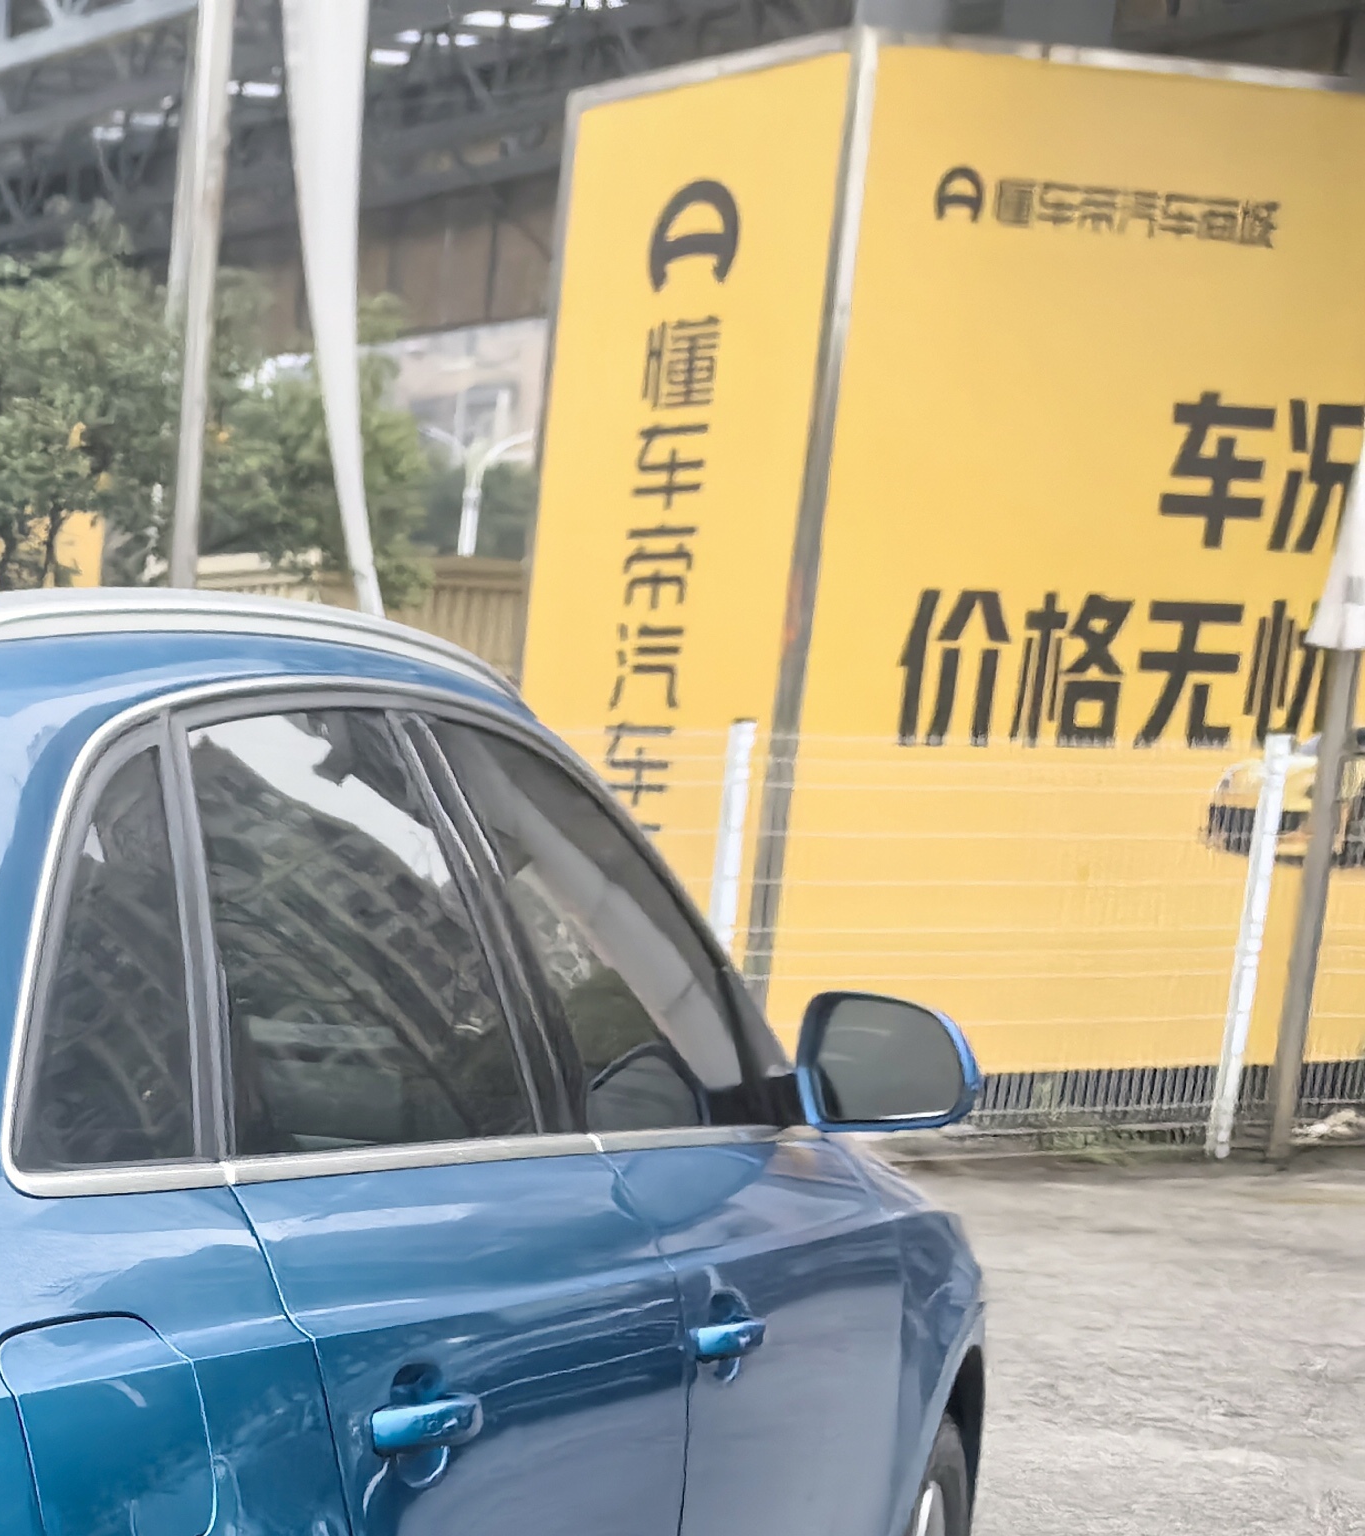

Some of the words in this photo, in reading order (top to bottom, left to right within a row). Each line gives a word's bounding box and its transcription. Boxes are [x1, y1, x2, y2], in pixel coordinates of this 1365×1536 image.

[603, 314, 723, 832] 懂车帝汽车
